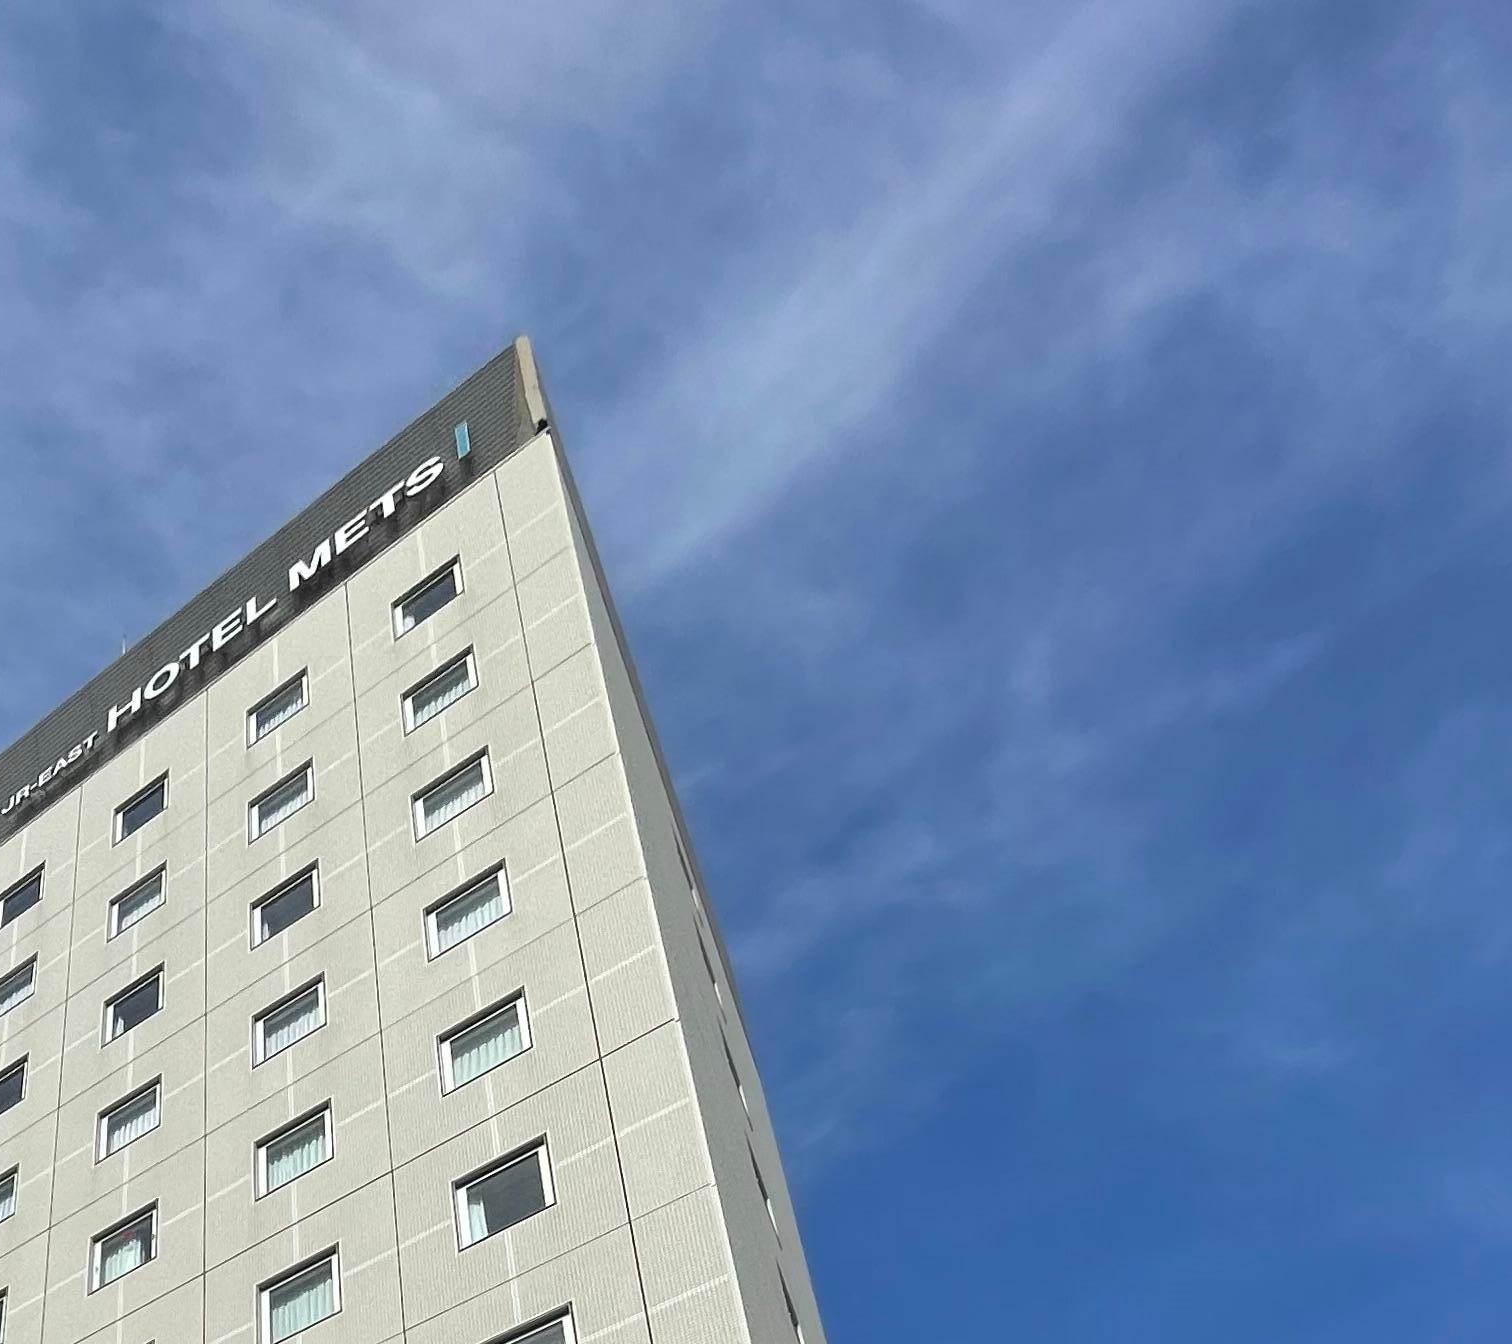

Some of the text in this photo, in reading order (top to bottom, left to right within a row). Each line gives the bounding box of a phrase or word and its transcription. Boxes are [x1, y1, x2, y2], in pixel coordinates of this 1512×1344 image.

[1, 455, 444, 815] JR-EAST HOTEL METS
